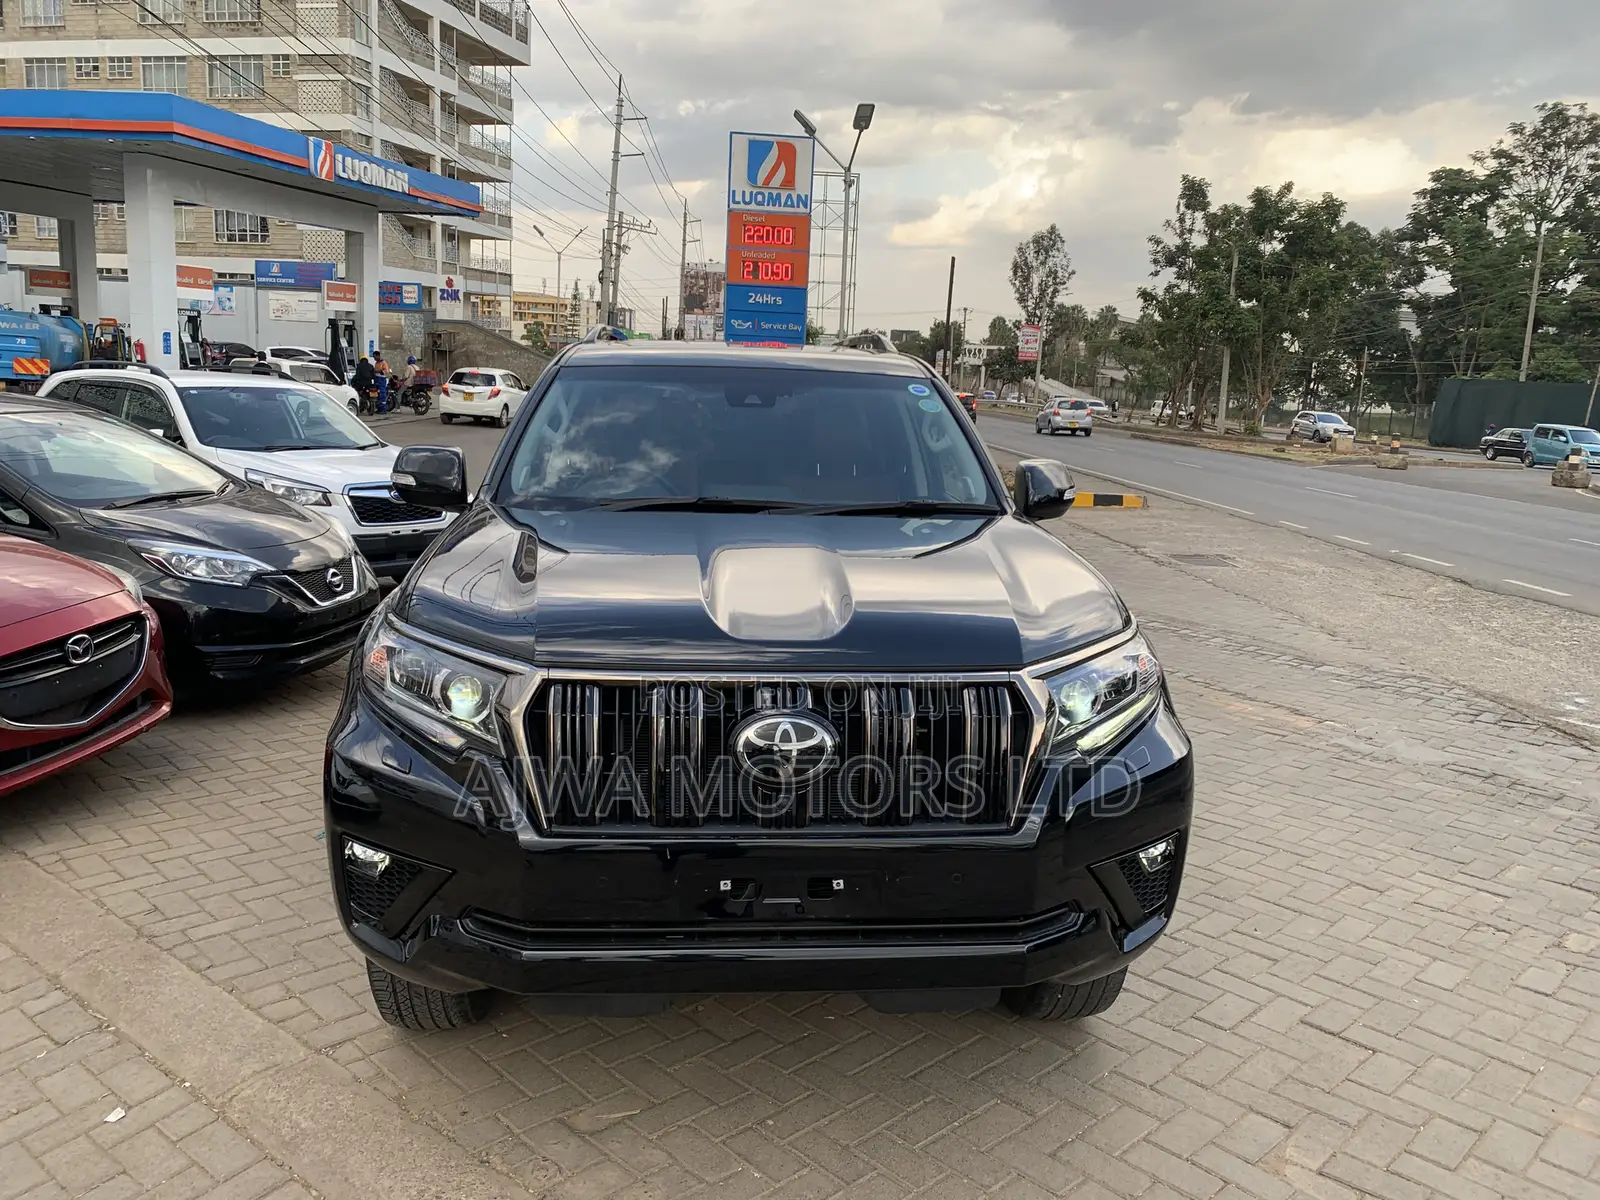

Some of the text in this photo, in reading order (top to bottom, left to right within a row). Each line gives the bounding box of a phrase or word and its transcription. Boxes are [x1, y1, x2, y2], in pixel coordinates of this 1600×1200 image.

[335, 153, 409, 194] LUQMAN
[731, 189, 809, 209] LUQMAN
[742, 214, 765, 222] Diesel
[741, 251, 776, 259] Unleaded
[439, 289, 461, 301] ZNK
[748, 293, 783, 305] 24Hrs
[0, 322, 40, 330] WAER
[760, 321, 802, 332] Service Bay
